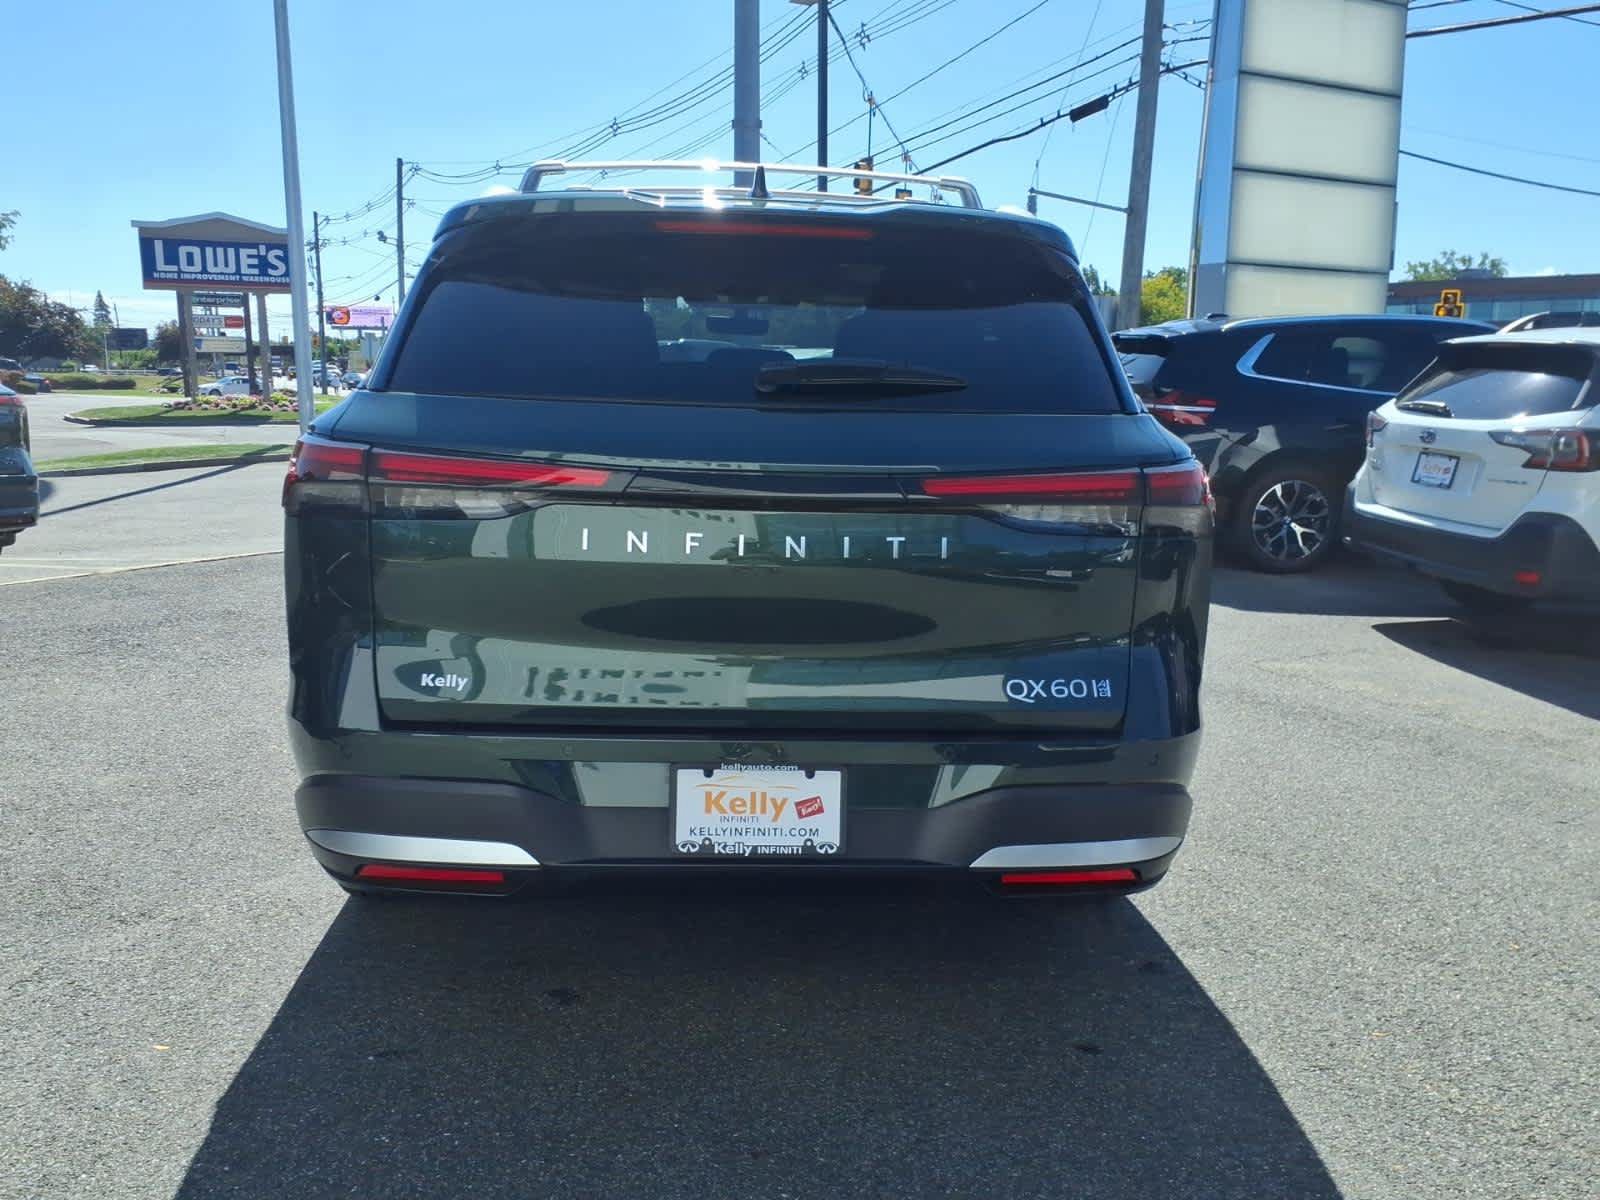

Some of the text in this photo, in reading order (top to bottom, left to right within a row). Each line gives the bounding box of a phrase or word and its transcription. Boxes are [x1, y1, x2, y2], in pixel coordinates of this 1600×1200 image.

[154, 239, 287, 276] LOWE'S
[153, 271, 178, 280] HOME
[180, 272, 240, 282] IMPROVEMENT
[581, 527, 949, 560] INFINITI
[420, 672, 469, 692] Kelly
[1006, 679, 1088, 703] QX60
[720, 762, 799, 772] kellyauto.com
[704, 790, 789, 823] Kelly
[720, 815, 760, 824] INFINITI
[689, 826, 820, 838] KELLYINFINITI.COM
[713, 841, 802, 857] Kelly INFINITI
